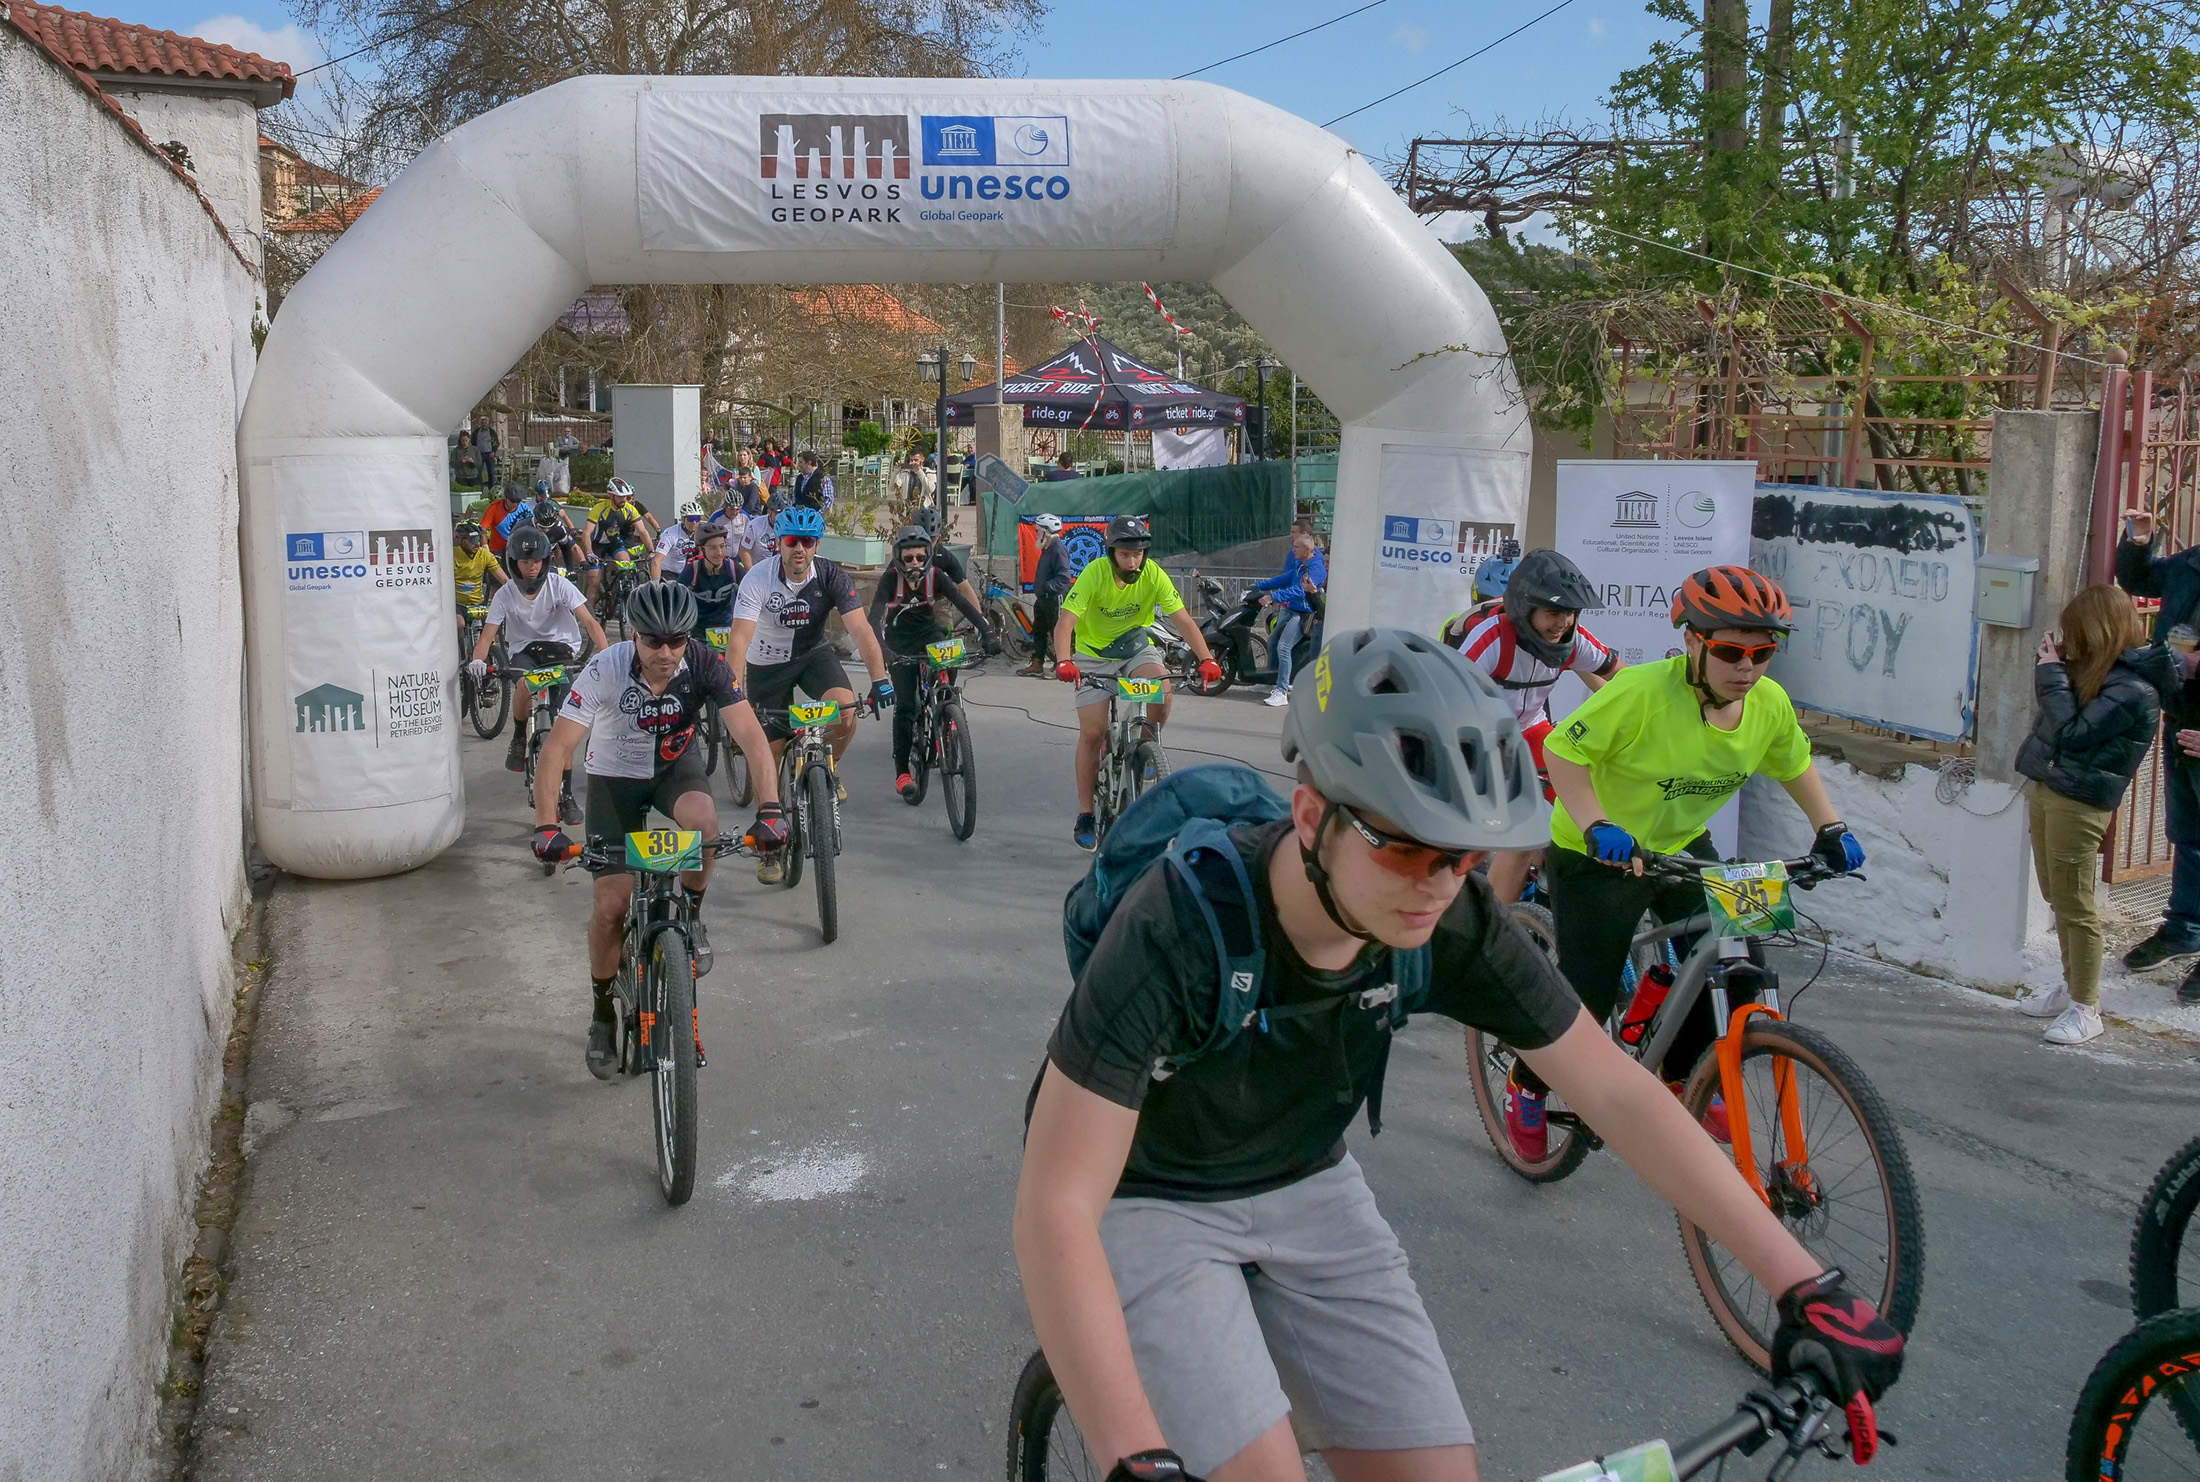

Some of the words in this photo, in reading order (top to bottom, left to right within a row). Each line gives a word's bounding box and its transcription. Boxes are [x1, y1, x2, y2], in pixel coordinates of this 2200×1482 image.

[771, 184, 901, 200] LESVOS
[920, 175, 1070, 200] unesco
[771, 207, 901, 223] GEOPARK
[920, 210, 955, 221] Global
[958, 210, 1004, 222] Geopark
[1024, 405, 1072, 422] 2ride.gr
[1166, 406, 1217, 420] ticket2ride.gr
[1616, 501, 1656, 520] UNESCO
[1382, 545, 1452, 563] unesco
[1460, 556, 1486, 564] LES
[288, 564, 367, 580] unesco
[375, 565, 431, 576] LESVOS
[1460, 567, 1475, 575] GE
[307, 583, 332, 591] Geopark
[375, 576, 433, 588] GEOPARK
[1582, 609, 1605, 617] itage
[1608, 608, 1620, 616] for
[1623, 609, 1646, 617] Rural
[1649, 611, 1670, 619] Rege
[388, 671, 440, 689] NATURAL
[389, 685, 440, 704] HISTORY
[1132, 682, 1150, 694] 30
[390, 700, 441, 719] MUSEUM
[804, 707, 824, 719] 37
[390, 720, 402, 729] OF
[403, 719, 419, 728] THE
[421, 715, 442, 725] LESVOS
[390, 727, 423, 738] PETRIFIED
[648, 831, 679, 856] 39
